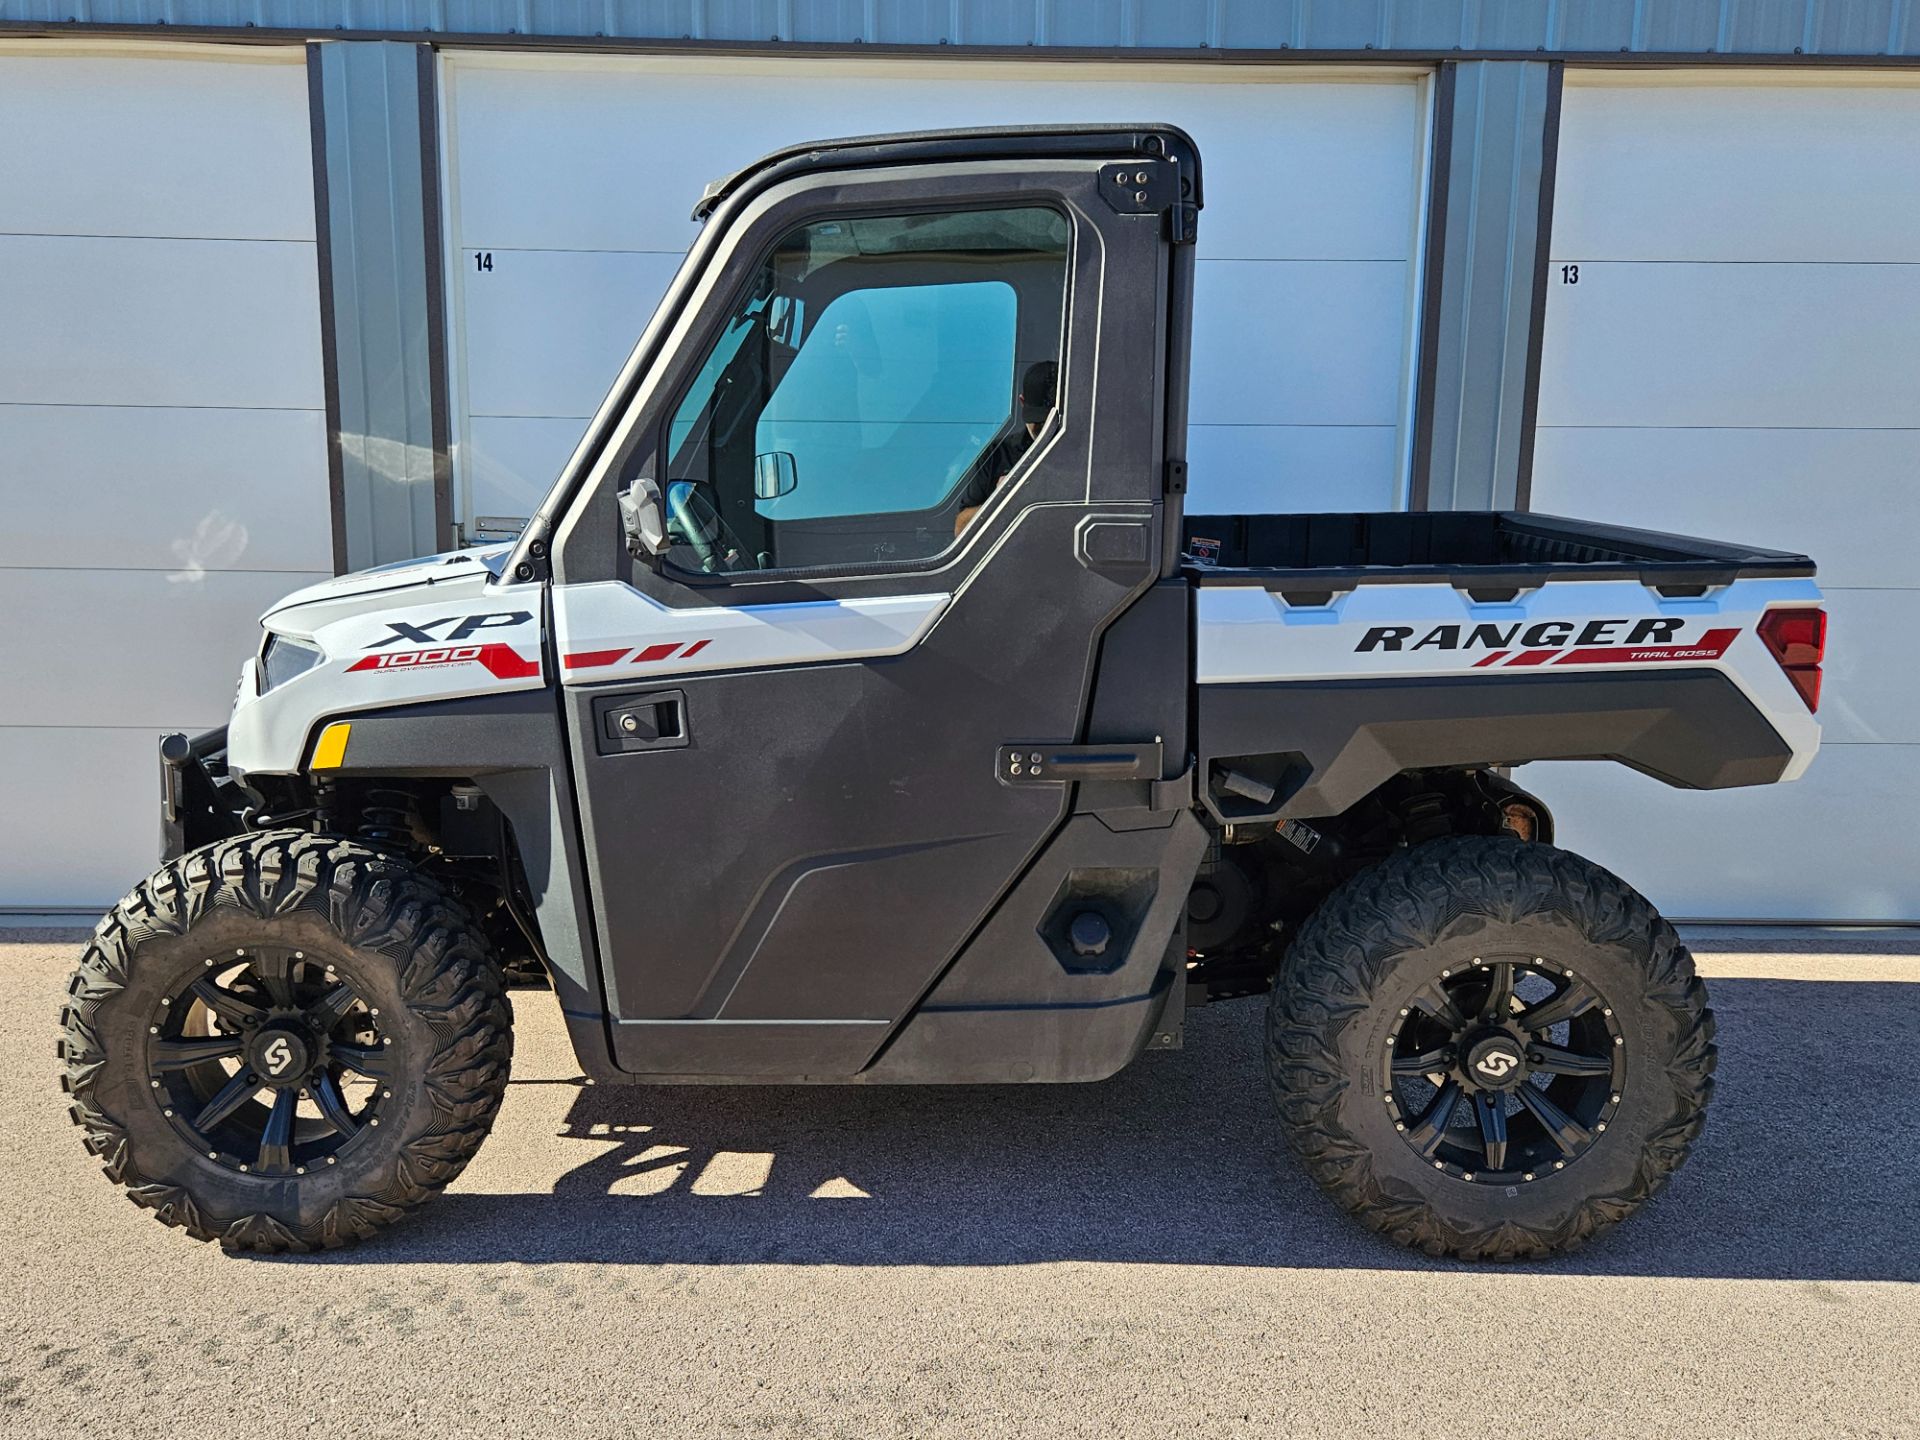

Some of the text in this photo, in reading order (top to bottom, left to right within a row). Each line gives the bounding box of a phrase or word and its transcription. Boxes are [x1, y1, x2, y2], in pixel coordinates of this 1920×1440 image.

[474, 251, 493, 272] 14
[1561, 264, 1579, 285] 13
[360, 610, 534, 650] XP
[1353, 617, 1686, 653] RANGER
[376, 646, 483, 668] 1000
[1630, 649, 1719, 660] TRAIL BOSS
[399, 663, 450, 673] OVERHEAD
